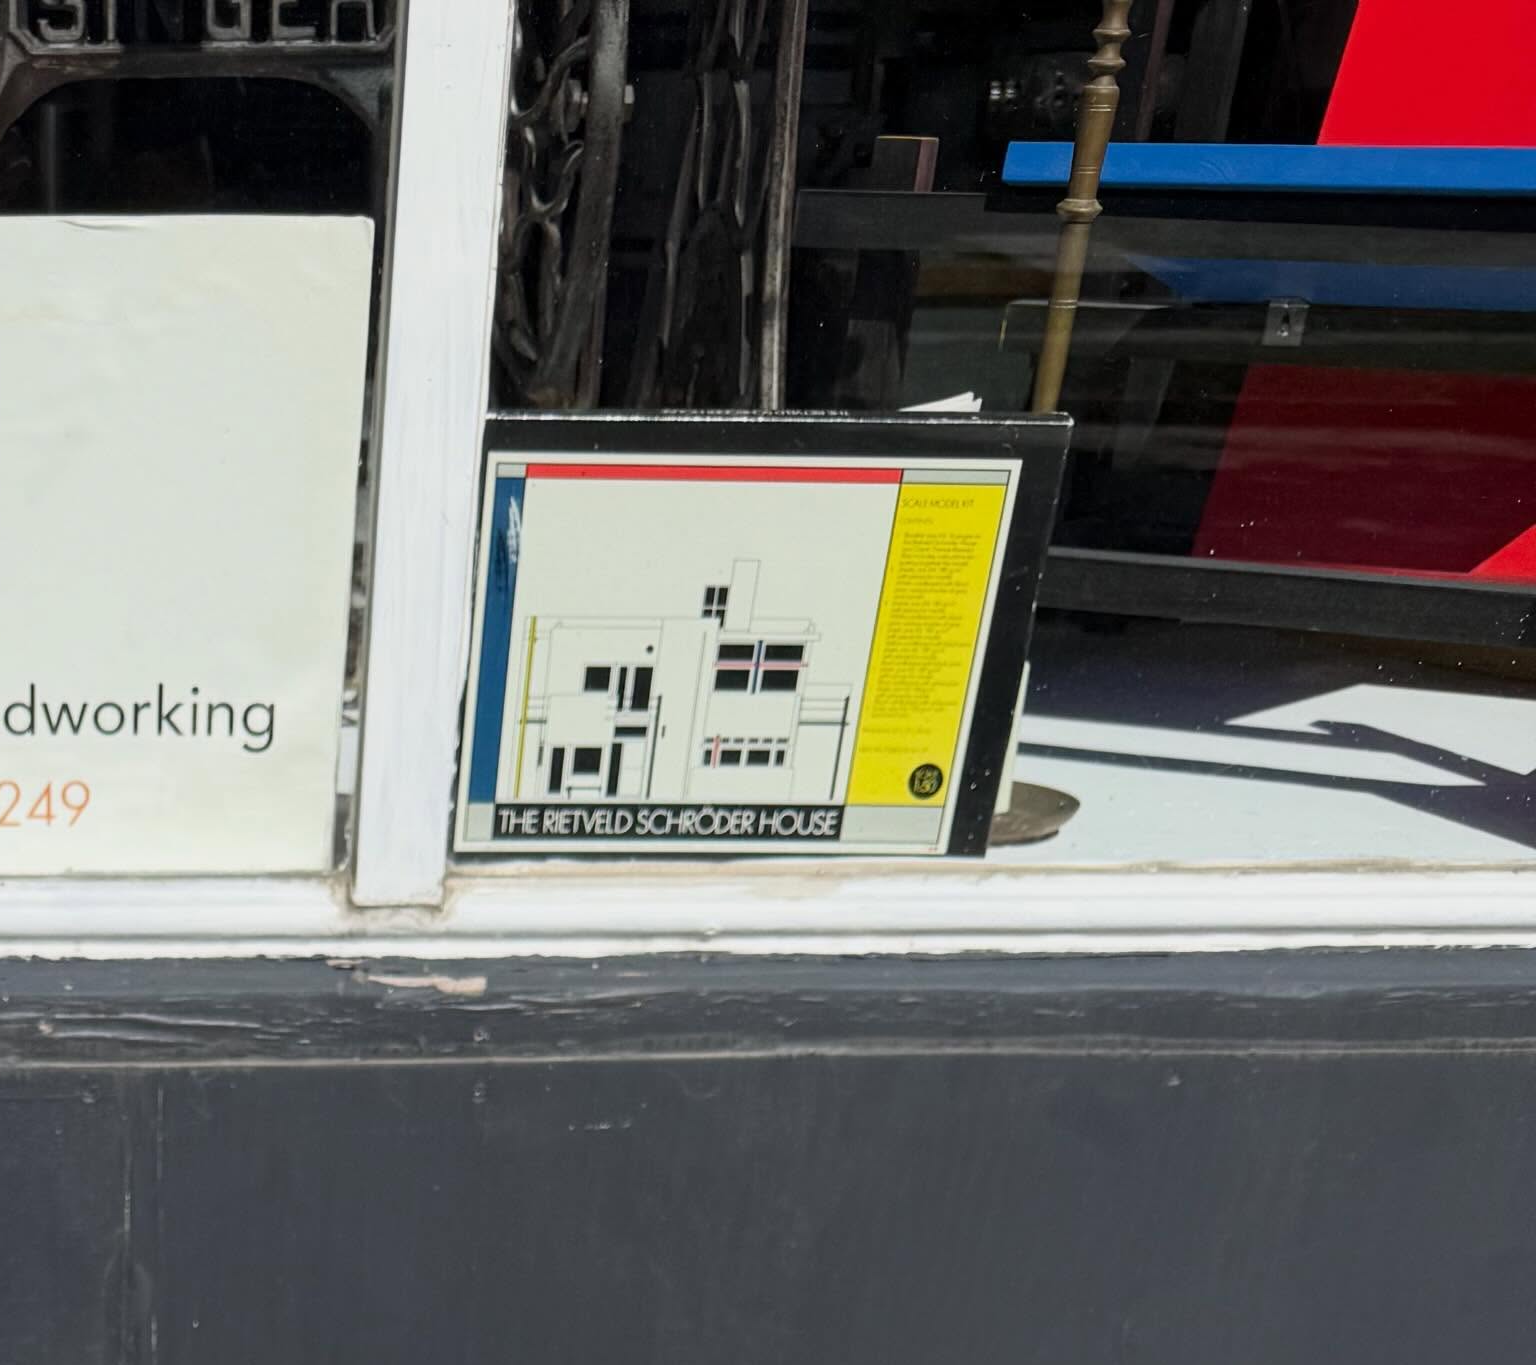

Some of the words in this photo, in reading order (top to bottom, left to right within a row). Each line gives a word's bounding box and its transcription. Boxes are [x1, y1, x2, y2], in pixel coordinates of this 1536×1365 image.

[498, 807, 540, 835] THE
[542, 808, 634, 835] RIETVELD
[635, 805, 756, 836] SCHRÖDER
[758, 808, 840, 836] HOUSE
